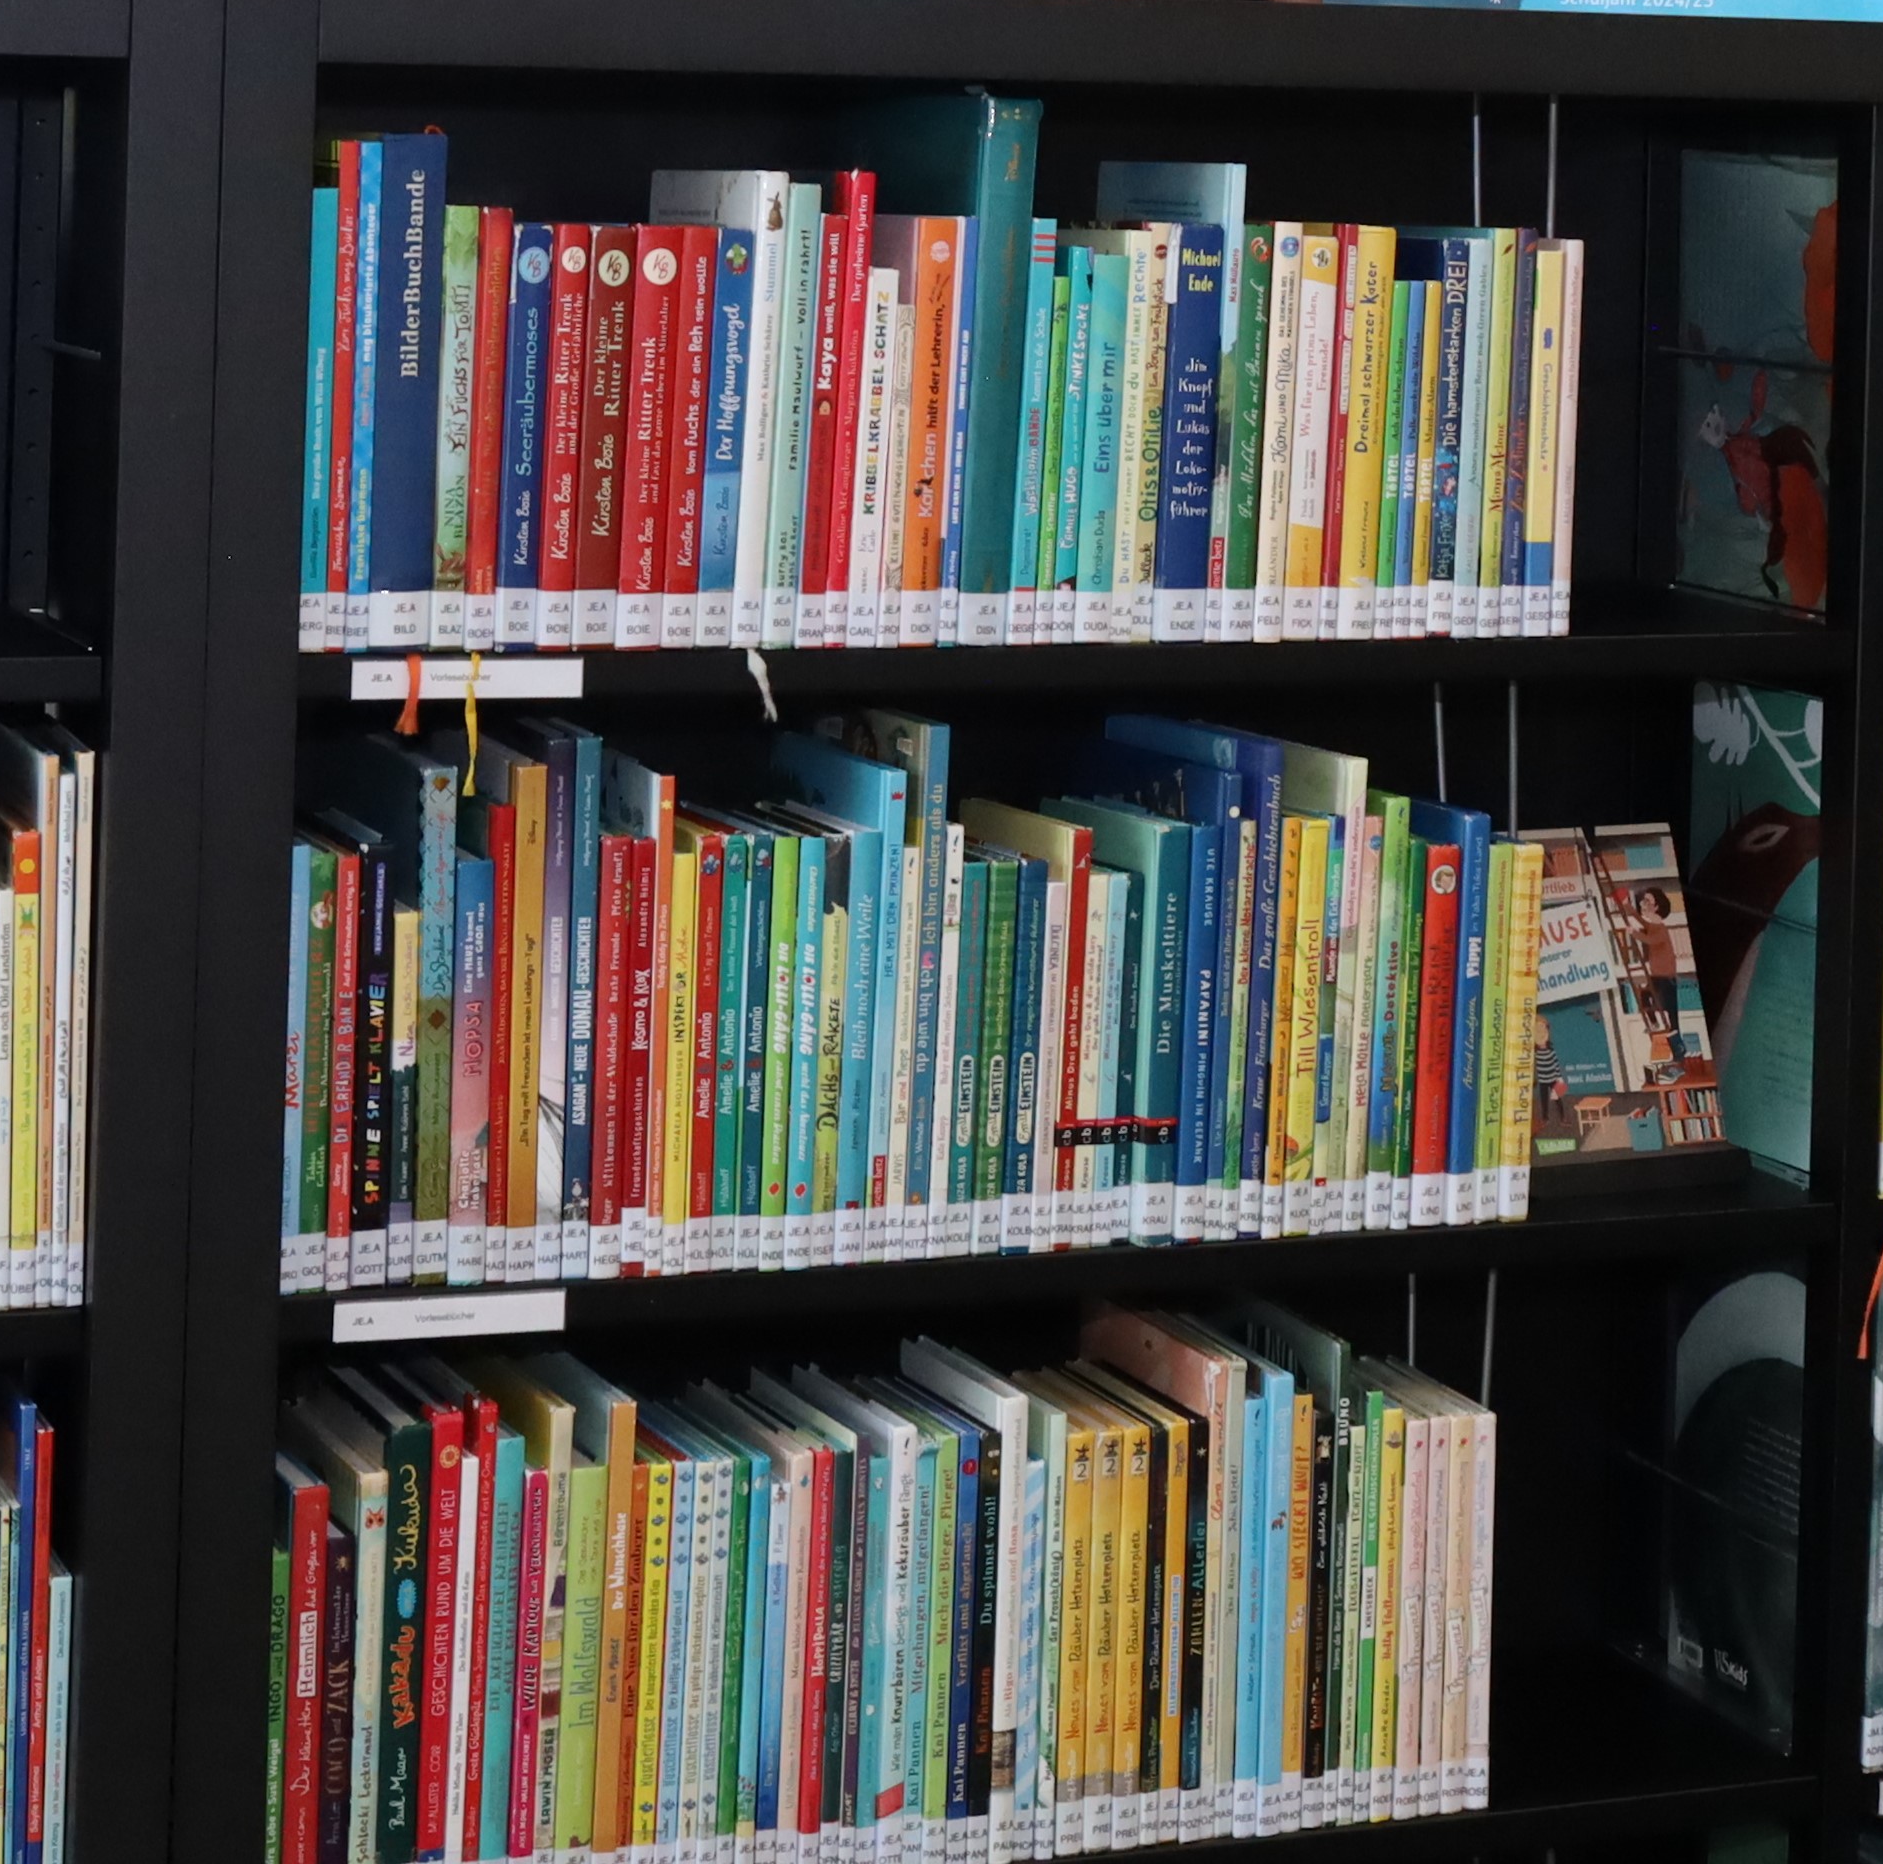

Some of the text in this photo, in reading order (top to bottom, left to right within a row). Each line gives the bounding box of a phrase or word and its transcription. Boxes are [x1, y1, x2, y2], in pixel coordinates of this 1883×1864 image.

[401, 169, 426, 377] BilderBuchBande
[1182, 248, 1222, 267] Michael
[1188, 274, 1214, 292] Ende
[604, 301, 625, 418] Ritter Trenk
[715, 302, 745, 461] Der Hoffnungsvogel
[1185, 358, 1208, 373] Jim
[1354, 261, 1378, 454] Dreimal schwarzer Kater
[515, 307, 539, 477] Seeräubermoses
[863, 291, 890, 515] KRIBBELKRABBEL SCHATZ
[1093, 341, 1115, 473] Eins über mir
[1178, 378, 1213, 399] Knopf
[1183, 400, 1206, 414] und
[1176, 419, 1211, 435] Lukas
[1182, 440, 1204, 455] der
[592, 433, 615, 537] Kirsten Boie
[1172, 480, 1208, 496] motiv-
[1175, 460, 1208, 476] Loko-
[676, 488, 696, 568] Kirsten Boie
[1170, 500, 1209, 520] führer
[393, 624, 416, 634] BILD
[394, 603, 416, 614] JE.A
[371, 673, 392, 683] JE.A
[1156, 891, 1178, 1056] Die Muskeltiere
[463, 1000, 484, 1078] MOPSA
[364, 972, 389, 1203] SPINNE SPIELT KLAVIER
[352, 1310, 476, 1328] JE.A Vorlesebücher
[1338, 1397, 1351, 1446] BRUNO
[608, 1512, 627, 1610] Der Wunschhase
[431, 1488, 456, 1717] GESCHICHTEN RUND UM DIE WELT
[1365, 1576, 1374, 1628] KNESEBECK
[392, 1624, 416, 1729] Kakadu
